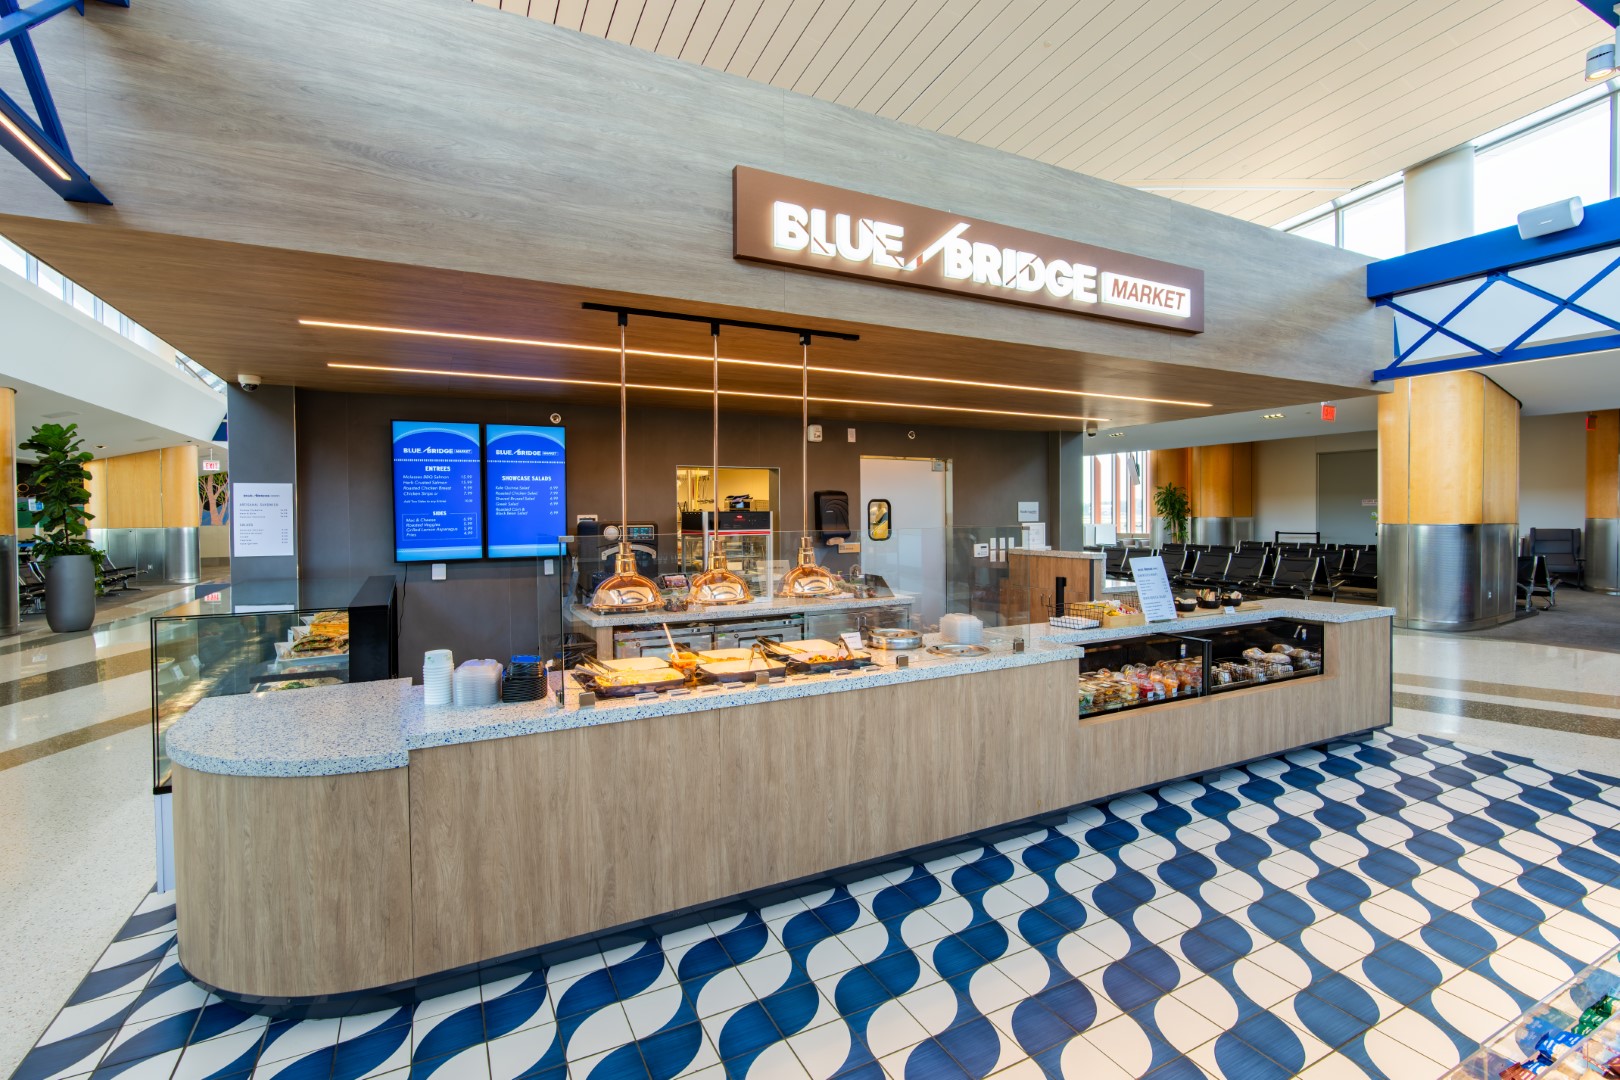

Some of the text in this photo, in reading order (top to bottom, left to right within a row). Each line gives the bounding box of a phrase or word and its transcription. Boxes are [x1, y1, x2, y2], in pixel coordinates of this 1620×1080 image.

[774, 200, 1186, 310] BLUE BRIDGE MARKET
